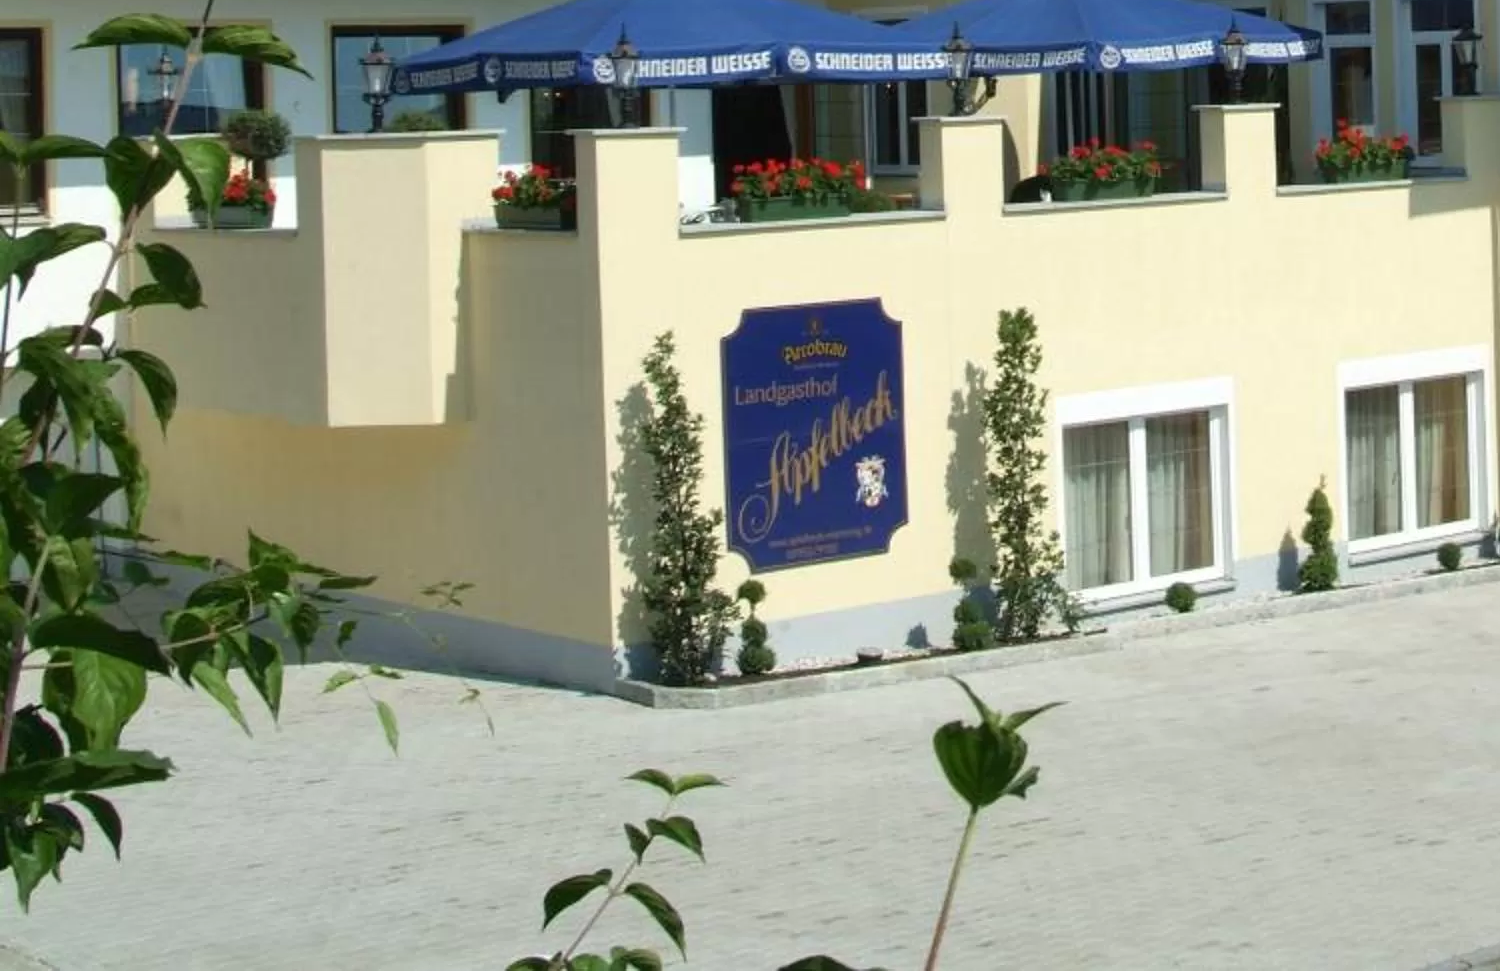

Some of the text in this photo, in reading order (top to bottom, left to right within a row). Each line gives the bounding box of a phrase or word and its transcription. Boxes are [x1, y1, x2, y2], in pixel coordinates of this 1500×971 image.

[634, 50, 772, 78] HNEIDER WEISSE
[815, 51, 893, 71] SCHNEIDER
[973, 46, 1087, 69] SCHNEIDER WEISSE
[735, 372, 838, 407] Landgasthof
